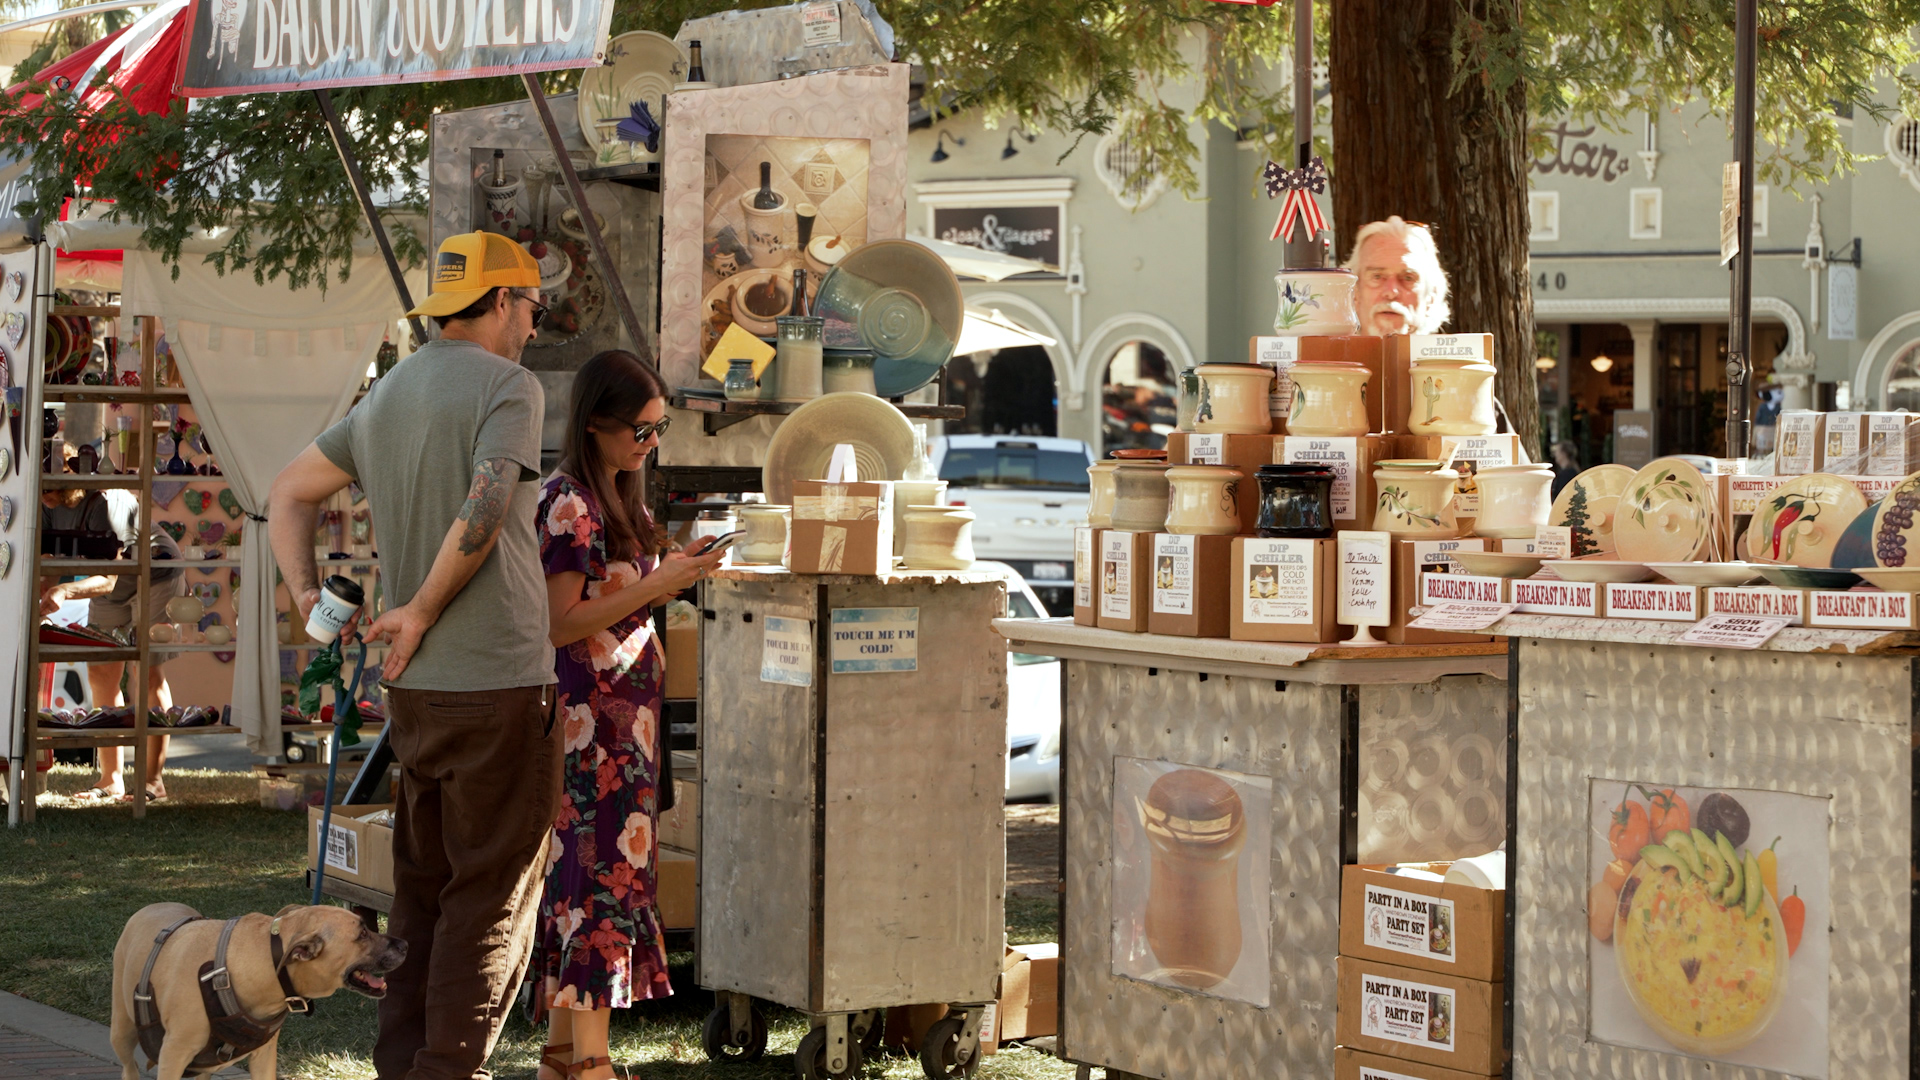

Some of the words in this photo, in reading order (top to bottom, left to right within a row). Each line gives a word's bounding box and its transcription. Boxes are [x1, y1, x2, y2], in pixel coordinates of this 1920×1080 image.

[942, 227, 983, 246] cloak
[1003, 227, 1053, 246] dagger
[1271, 341, 1284, 350] DIP
[1436, 337, 1458, 346] DIP
[1263, 351, 1292, 359] CHILLER
[1421, 347, 1473, 356] CHILLER
[1200, 438, 1210, 446] DIP
[1310, 441, 1330, 450] DIP
[1467, 440, 1487, 448] DIP
[1194, 447, 1217, 456] CHILLER
[1294, 451, 1346, 460] CHILLER
[1733, 481, 1764, 490] OMELETTE
[1875, 481, 1882, 490] IN
[1884, 481, 1889, 490] A
[1733, 499, 1755, 511] EGG
[1169, 536, 1180, 544] DIP
[1113, 542, 1121, 550] DIP
[1160, 546, 1188, 554] CHILLER
[1269, 544, 1289, 553] DIP
[1439, 542, 1459, 551] DIP
[1107, 552, 1127, 560] CHILLER
[1254, 554, 1303, 563] CHILLER
[1352, 577, 1374, 586] Venmo
[1428, 579, 1466, 600] BREAKFAST
[1468, 582, 1475, 600] IN
[1477, 582, 1482, 601] A
[1484, 583, 1497, 602] BOX
[1517, 585, 1557, 605] BREAKFAST
[1560, 586, 1567, 605] IN
[1569, 587, 1574, 606] A
[1576, 588, 1591, 607] BOX
[1612, 589, 1656, 610] BREAKFAST
[1658, 591, 1666, 610] IN
[1668, 591, 1674, 611] A
[1676, 592, 1691, 612] BOX
[1714, 592, 1760, 614] BREAKFAST
[1763, 594, 1771, 614] IN
[1774, 594, 1779, 614] A
[1782, 595, 1798, 615] BOX
[1817, 596, 1865, 617] BREAKFAST
[1868, 597, 1877, 617] IN
[1880, 597, 1886, 617] A
[1888, 597, 1905, 618] BOX
[1710, 624, 1761, 632] SPECIAL
[834, 630, 874, 640] TOUCH
[878, 630, 895, 639] ME
[898, 630, 915, 639] I'M
[766, 639, 788, 650] TOUCH
[790, 640, 799, 651] ME
[801, 642, 811, 652] I'M
[860, 644, 893, 654] COLD!
[780, 655, 799, 666] COLD!
[1368, 892, 1392, 906] PARTY
[1394, 897, 1402, 908] IN
[1404, 899, 1409, 910] A
[1411, 900, 1427, 914] BOX
[1387, 917, 1410, 932] PARTY
[1412, 922, 1425, 935] SET
[1366, 981, 1391, 996] PARTY
[1393, 986, 1401, 998] IN
[1403, 988, 1409, 1000] A
[1411, 989, 1427, 1003] BOX
[1385, 1006, 1409, 1022] PARTY
[1411, 1011, 1424, 1024] SET
